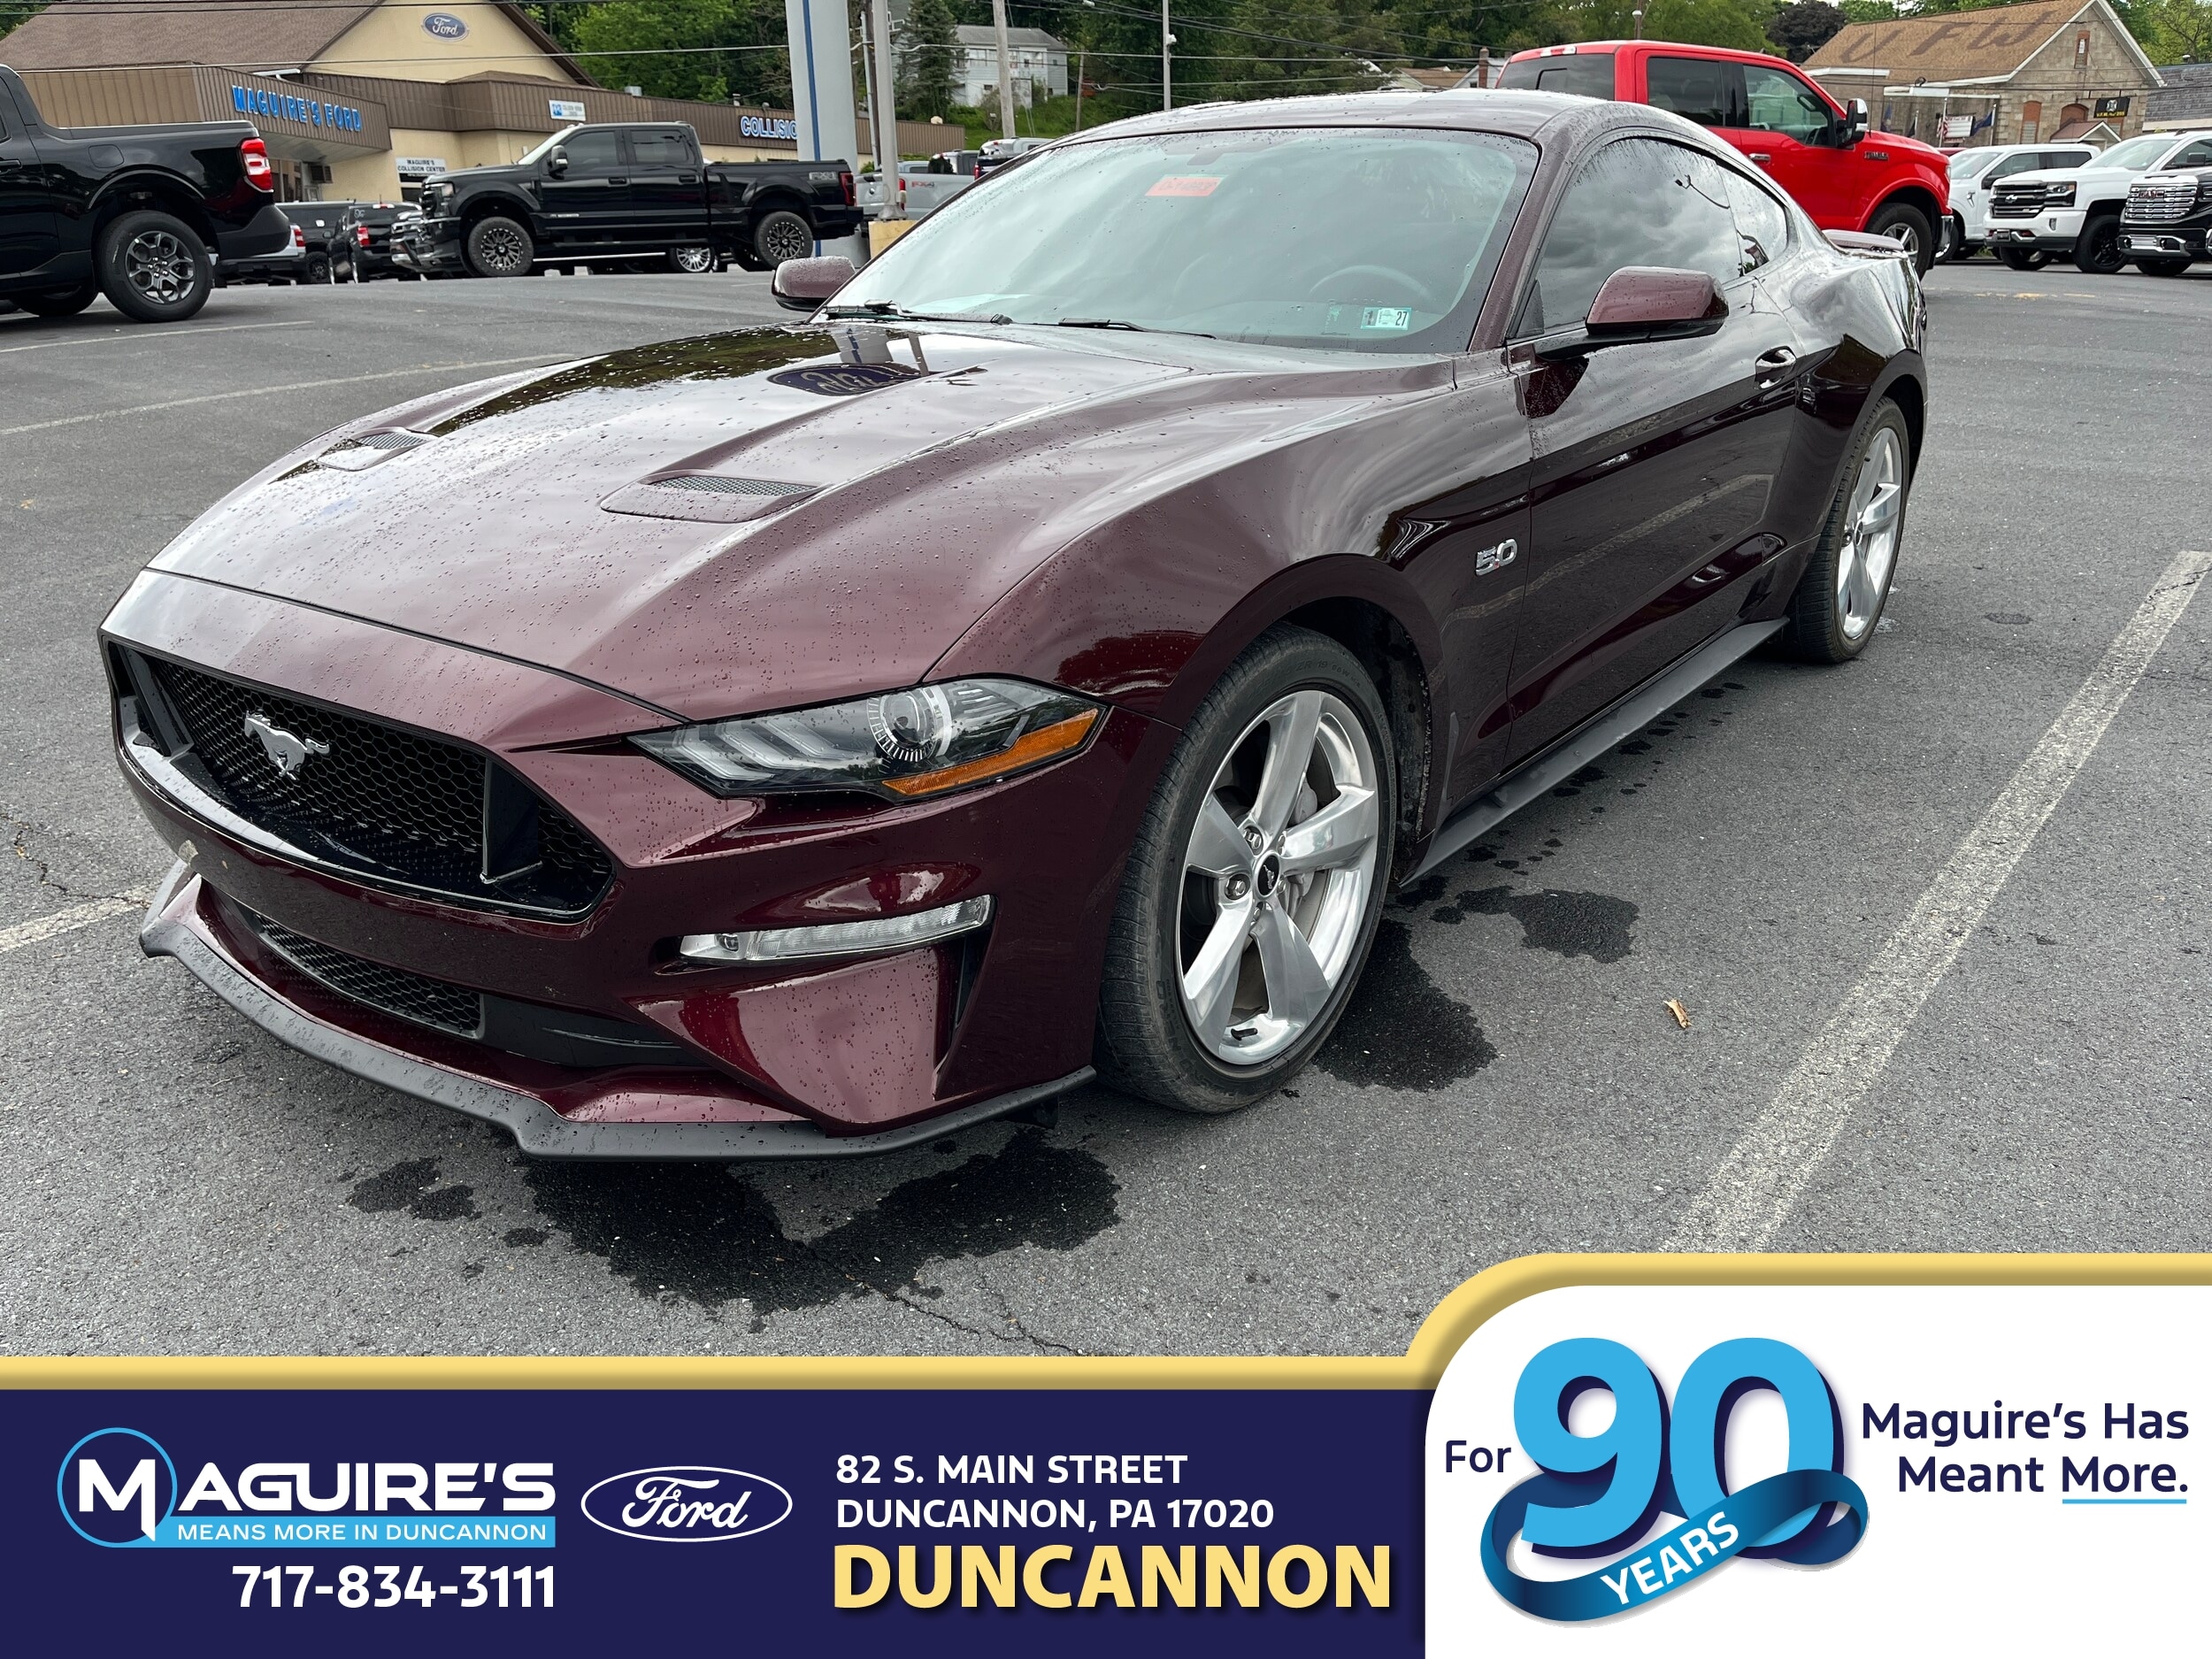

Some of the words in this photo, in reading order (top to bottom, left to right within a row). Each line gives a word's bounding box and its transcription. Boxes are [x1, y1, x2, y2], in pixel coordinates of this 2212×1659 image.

[432, 17, 459, 35] Ford
[232, 85, 322, 127] MAGUIRE'S
[324, 104, 362, 132] FORD
[1395, 311, 1408, 327] 27
[1475, 538, 1517, 576] 5.0
